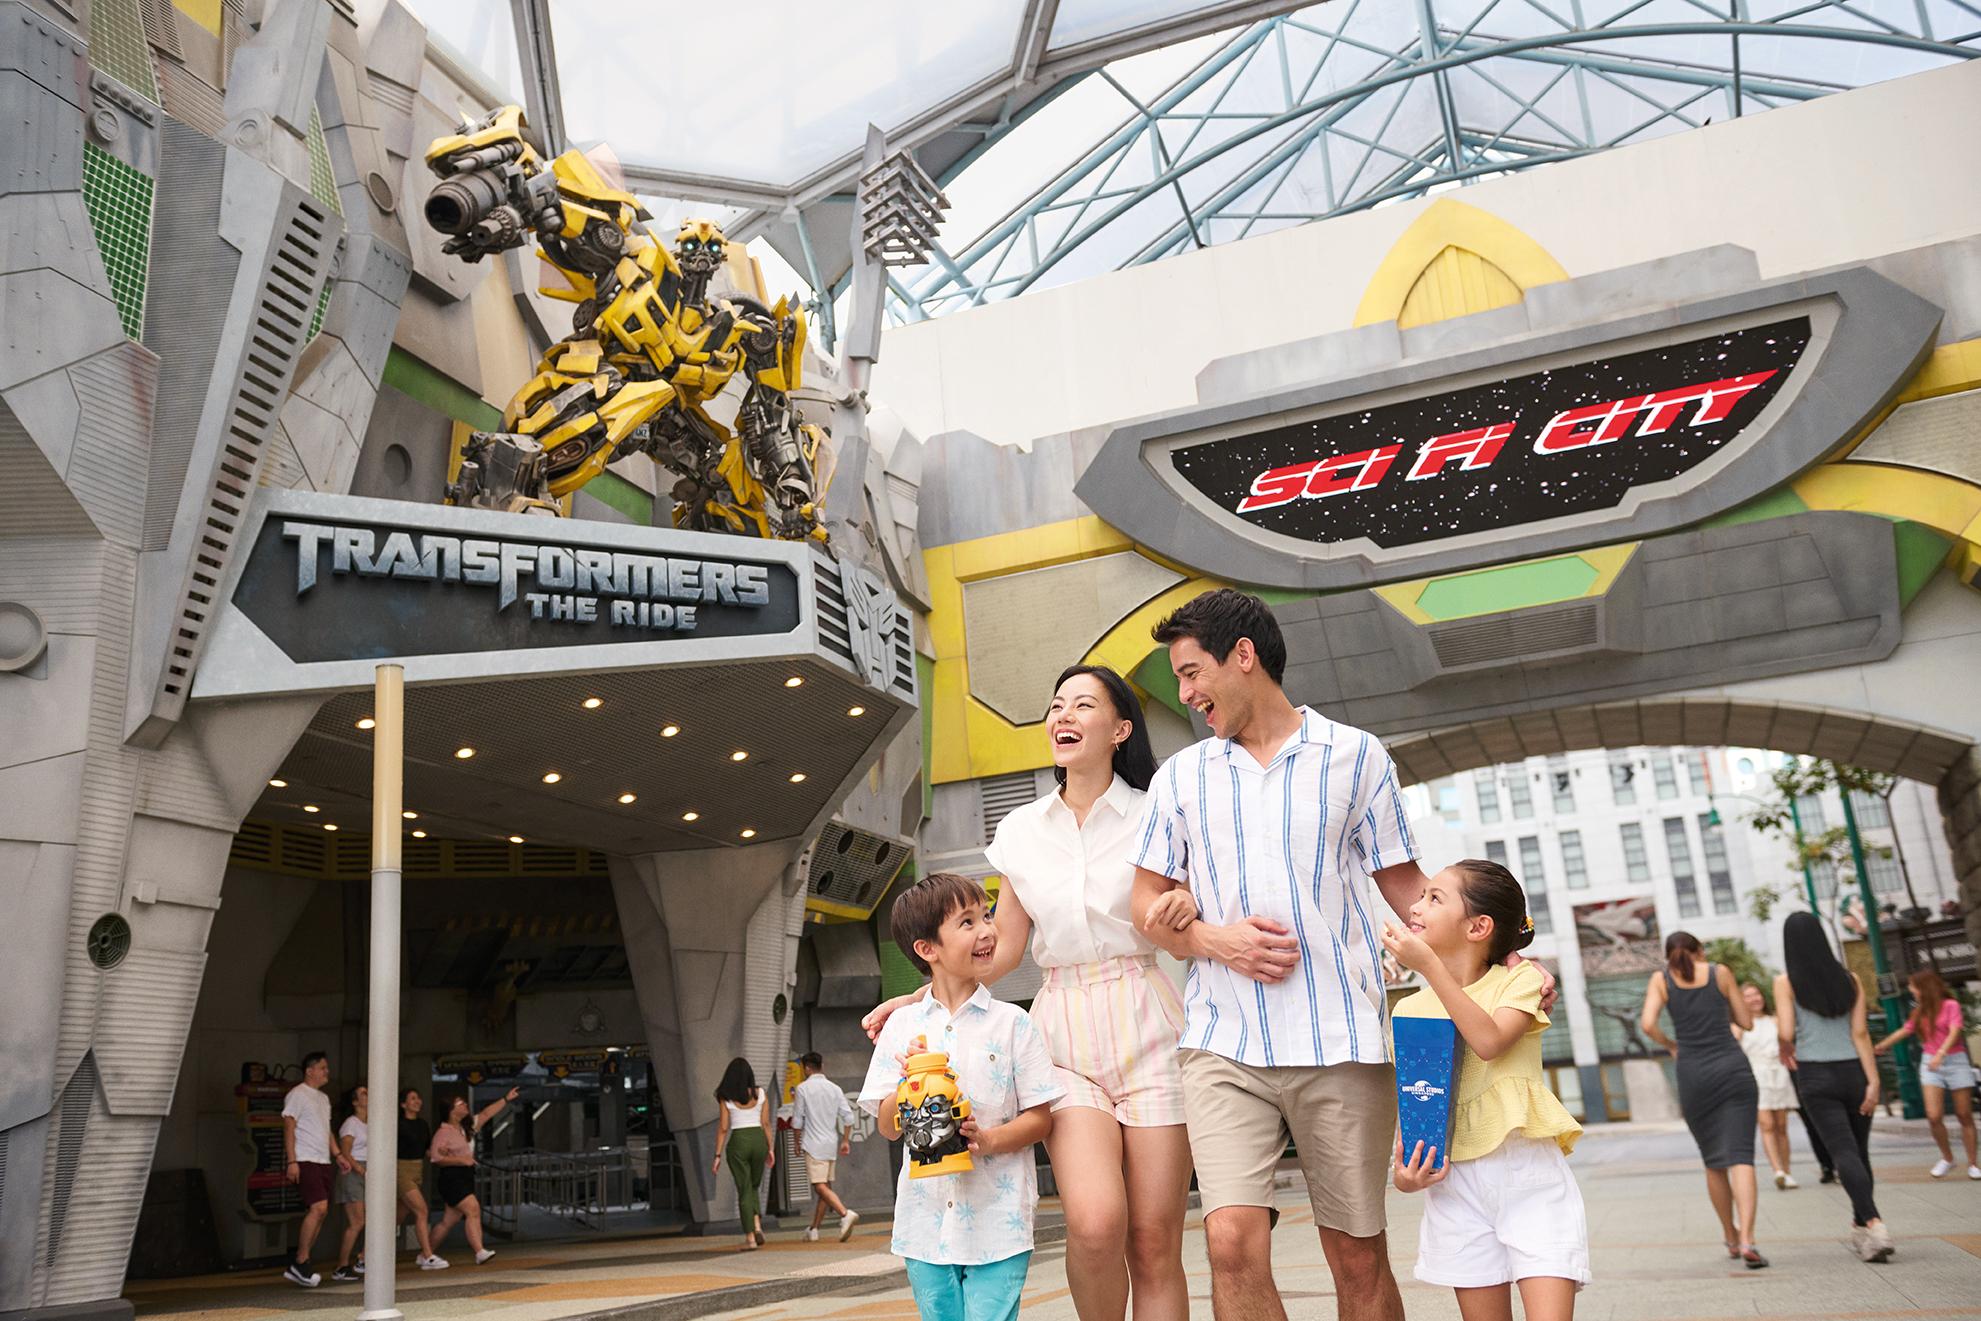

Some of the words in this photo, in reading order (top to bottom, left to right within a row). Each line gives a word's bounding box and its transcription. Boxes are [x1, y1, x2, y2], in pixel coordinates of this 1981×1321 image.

[1235, 443, 1404, 514] SCI
[1404, 421, 1518, 482] FI
[1532, 368, 1780, 456] CITY
[282, 520, 771, 613] TRANSFORMERS
[525, 592, 598, 624] THE
[609, 599, 698, 631] RIDE
